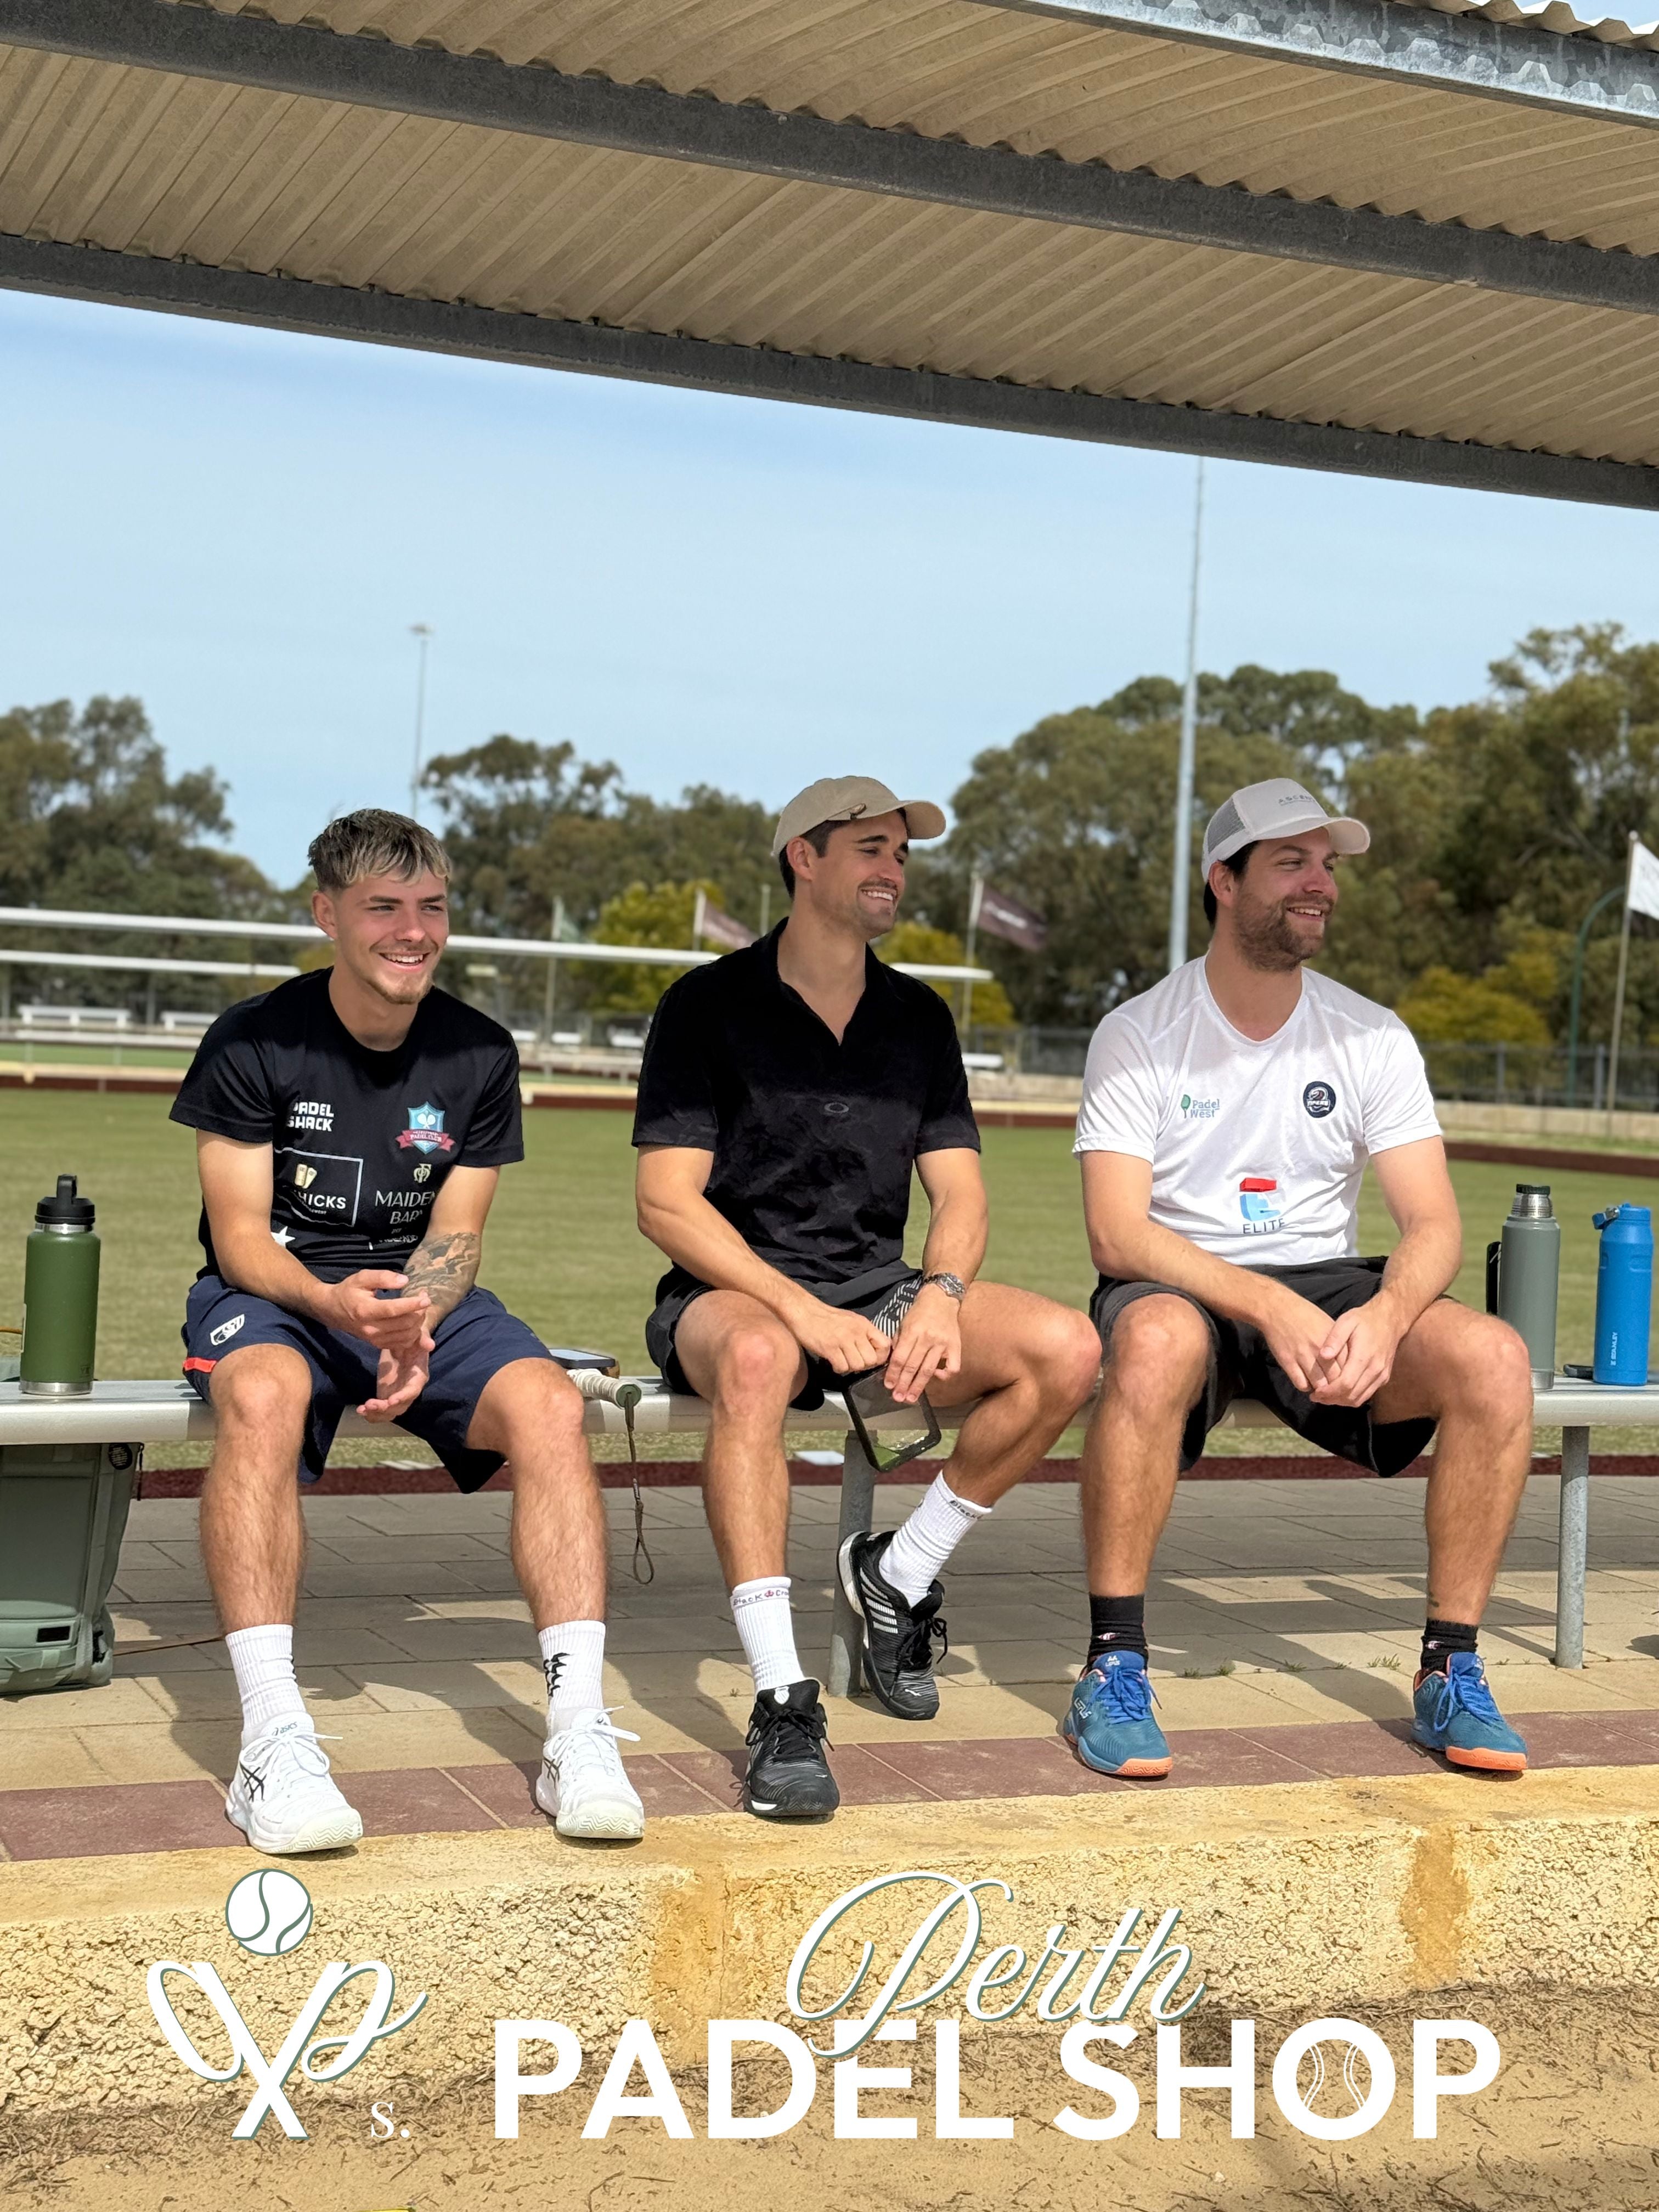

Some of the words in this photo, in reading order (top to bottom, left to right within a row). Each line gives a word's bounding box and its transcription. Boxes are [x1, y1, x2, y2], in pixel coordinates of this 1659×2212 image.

[1192, 1098, 1220, 1109] Padel
[1190, 1109, 1215, 1119] West
[1243, 1218, 1285, 1234] ELITE
